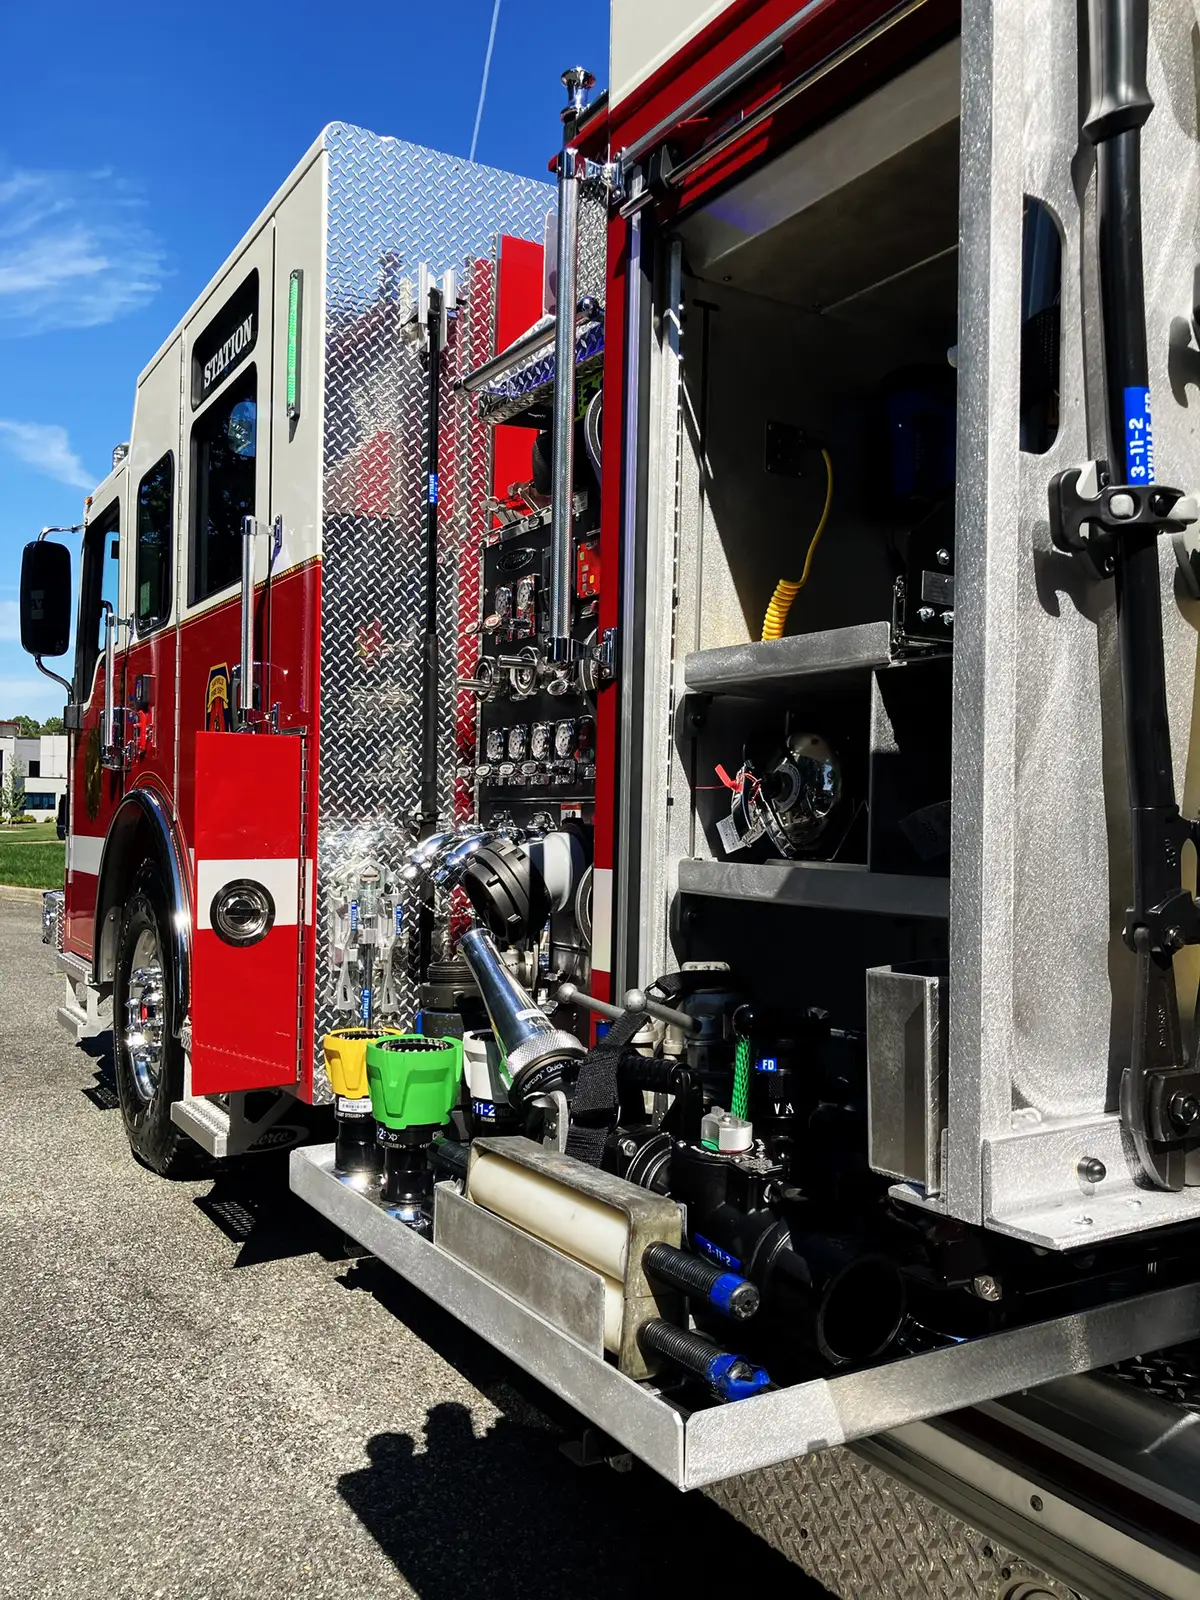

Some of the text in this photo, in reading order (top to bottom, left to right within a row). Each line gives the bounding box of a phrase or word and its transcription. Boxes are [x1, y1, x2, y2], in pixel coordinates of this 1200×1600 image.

[204, 313, 253, 389] STATION
[1129, 418, 1145, 478] 3-11-2
[762, 1059, 775, 1070] FD
[253, 1131, 289, 1146] ierce
